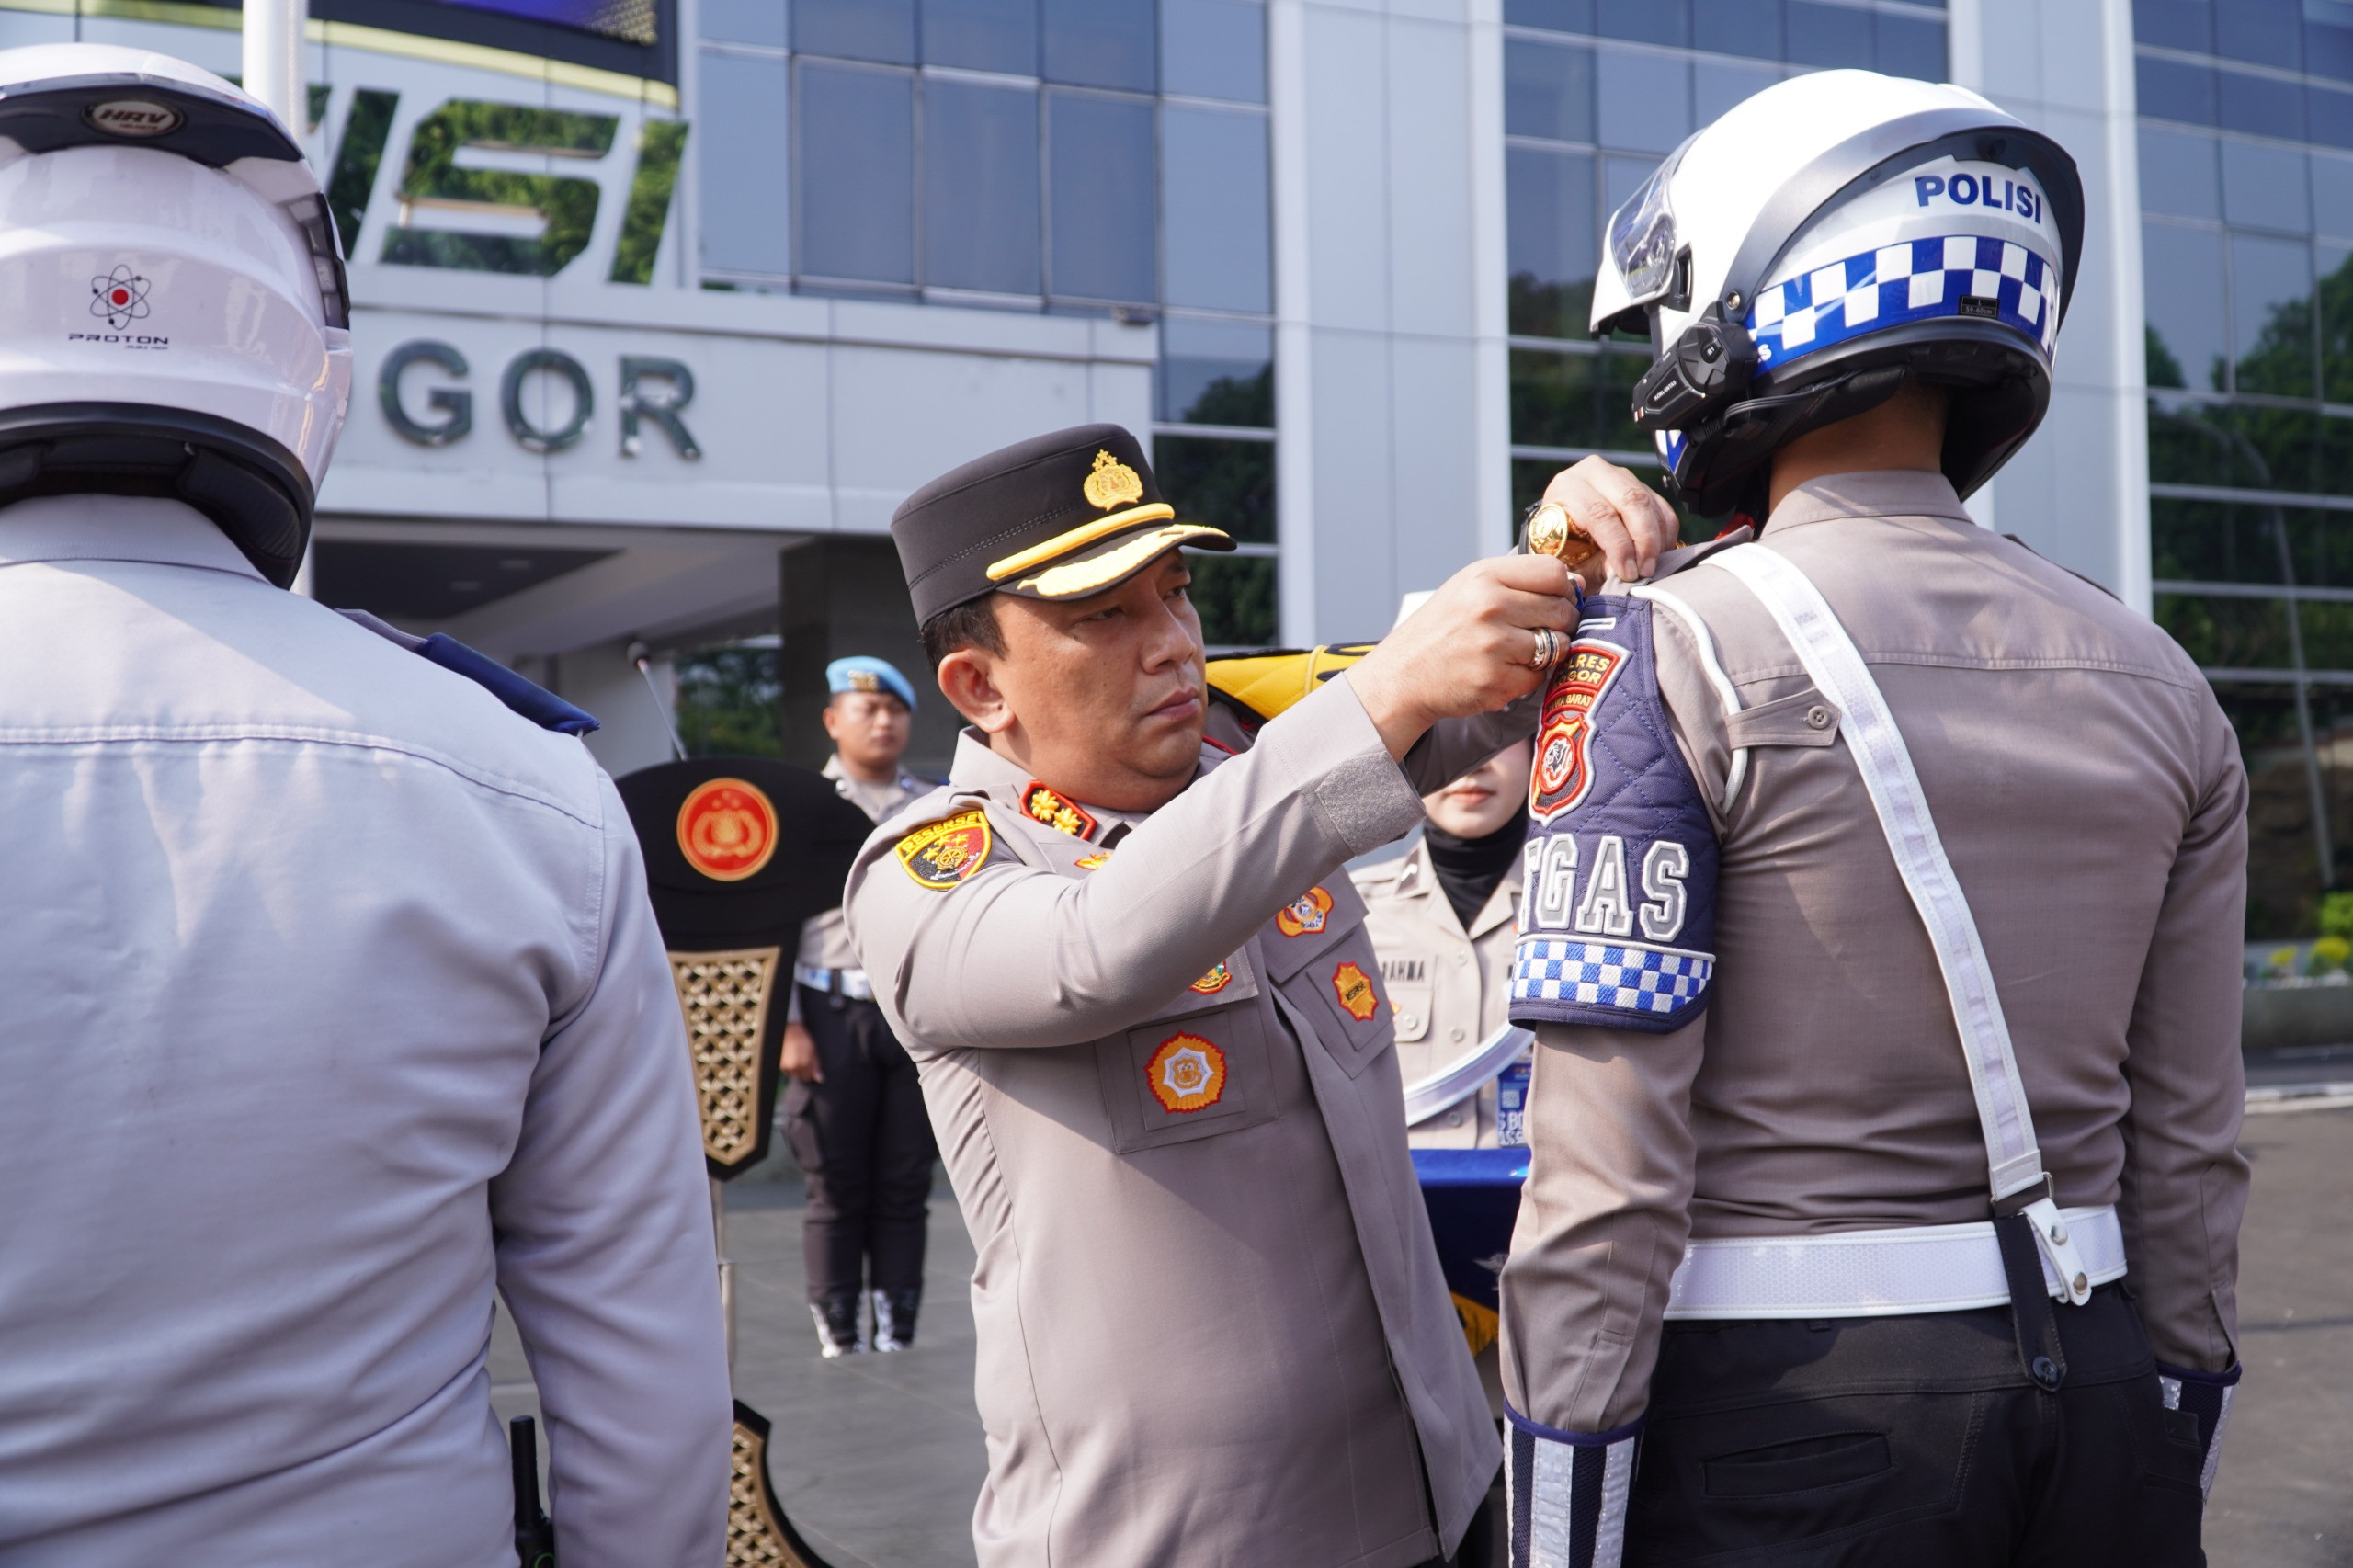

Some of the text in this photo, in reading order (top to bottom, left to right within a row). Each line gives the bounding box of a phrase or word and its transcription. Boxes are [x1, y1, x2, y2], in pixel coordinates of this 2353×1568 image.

[99, 108, 168, 124] HRV
[1915, 173, 2041, 224] POLISI
[69, 334, 168, 344] PROTON
[378, 336, 702, 462] GOR
[901, 813, 978, 854] RESERSE
